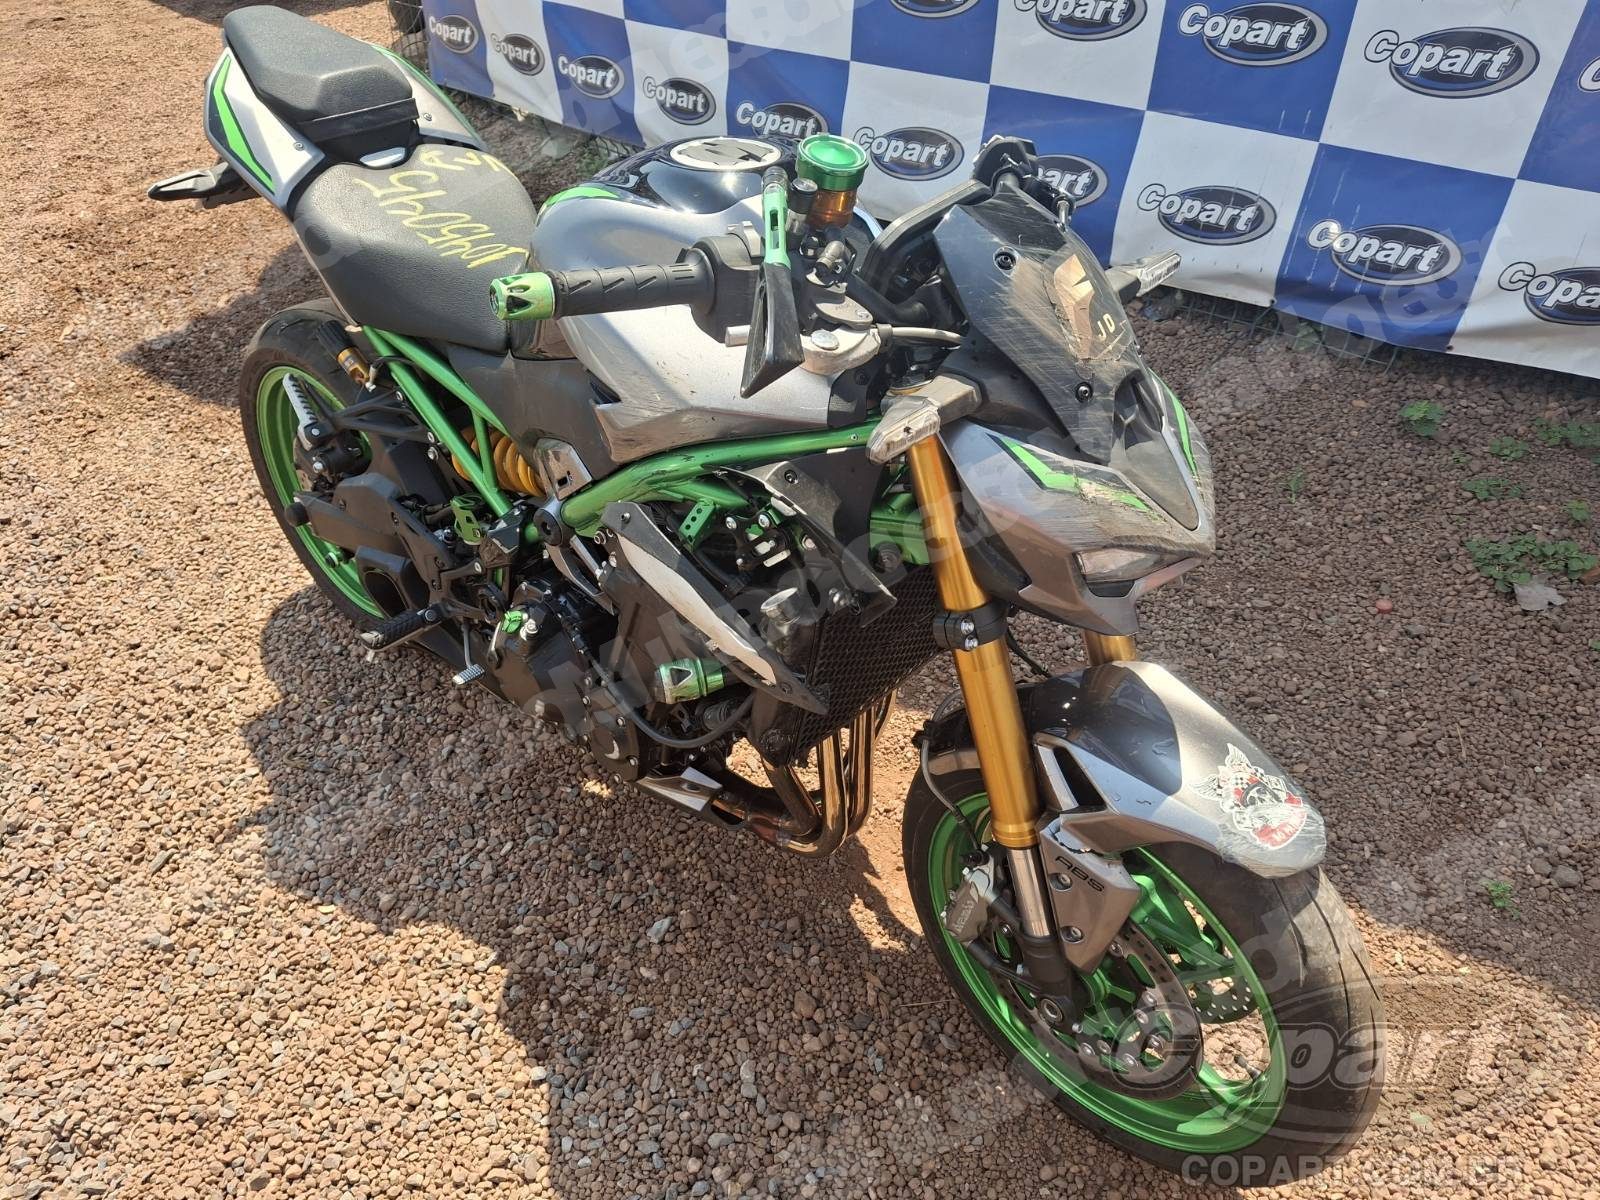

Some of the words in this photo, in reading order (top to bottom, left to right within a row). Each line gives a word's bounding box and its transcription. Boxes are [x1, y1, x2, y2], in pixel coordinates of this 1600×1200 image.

[428, 16, 473, 47] Copart
[1179, 3, 1312, 51] Copart
[490, 33, 538, 66] Copart
[1364, 29, 1519, 80] Copart
[557, 55, 616, 89] Copart
[642, 76, 706, 113] Copart
[736, 102, 816, 137] Copart
[853, 126, 950, 168] Copart
[1037, 167, 1092, 195] art
[1137, 183, 1262, 233] Copart
[1308, 219, 1446, 273] Copart
[1055, 855, 1104, 892] ABS
